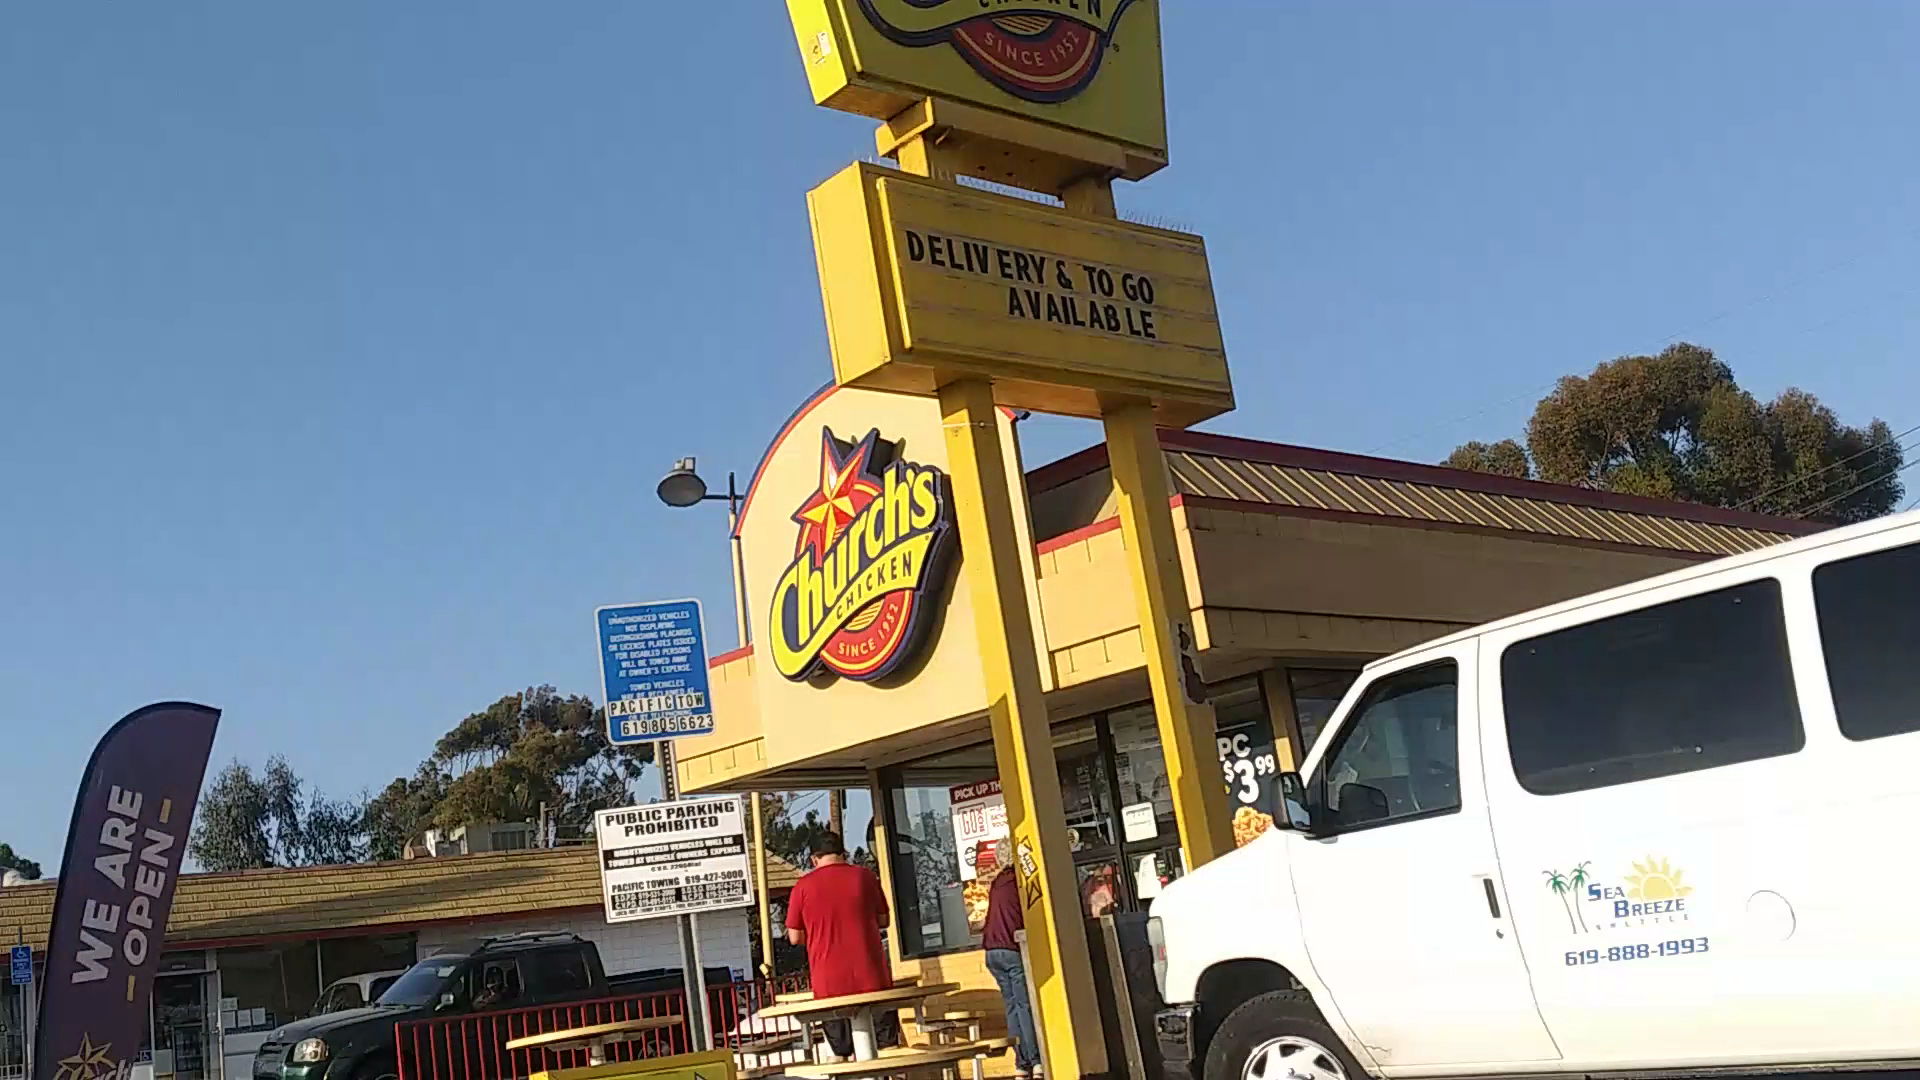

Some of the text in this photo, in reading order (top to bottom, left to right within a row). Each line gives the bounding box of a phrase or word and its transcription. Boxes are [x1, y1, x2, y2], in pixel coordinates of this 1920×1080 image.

[985, 31, 1079, 66] SINCE 1952
[906, 230, 1155, 304] DELIVERY & TO GO
[1008, 287, 1156, 339] AVAILABLE
[769, 463, 937, 676] Church's
[836, 550, 912, 622] CHICKEN
[838, 603, 899, 657] SINCE 1952
[610, 693, 704, 716] PACIFIC TOW
[1216, 733, 1252, 762] PC
[953, 785, 976, 801] PICK
[975, 782, 989, 796] UP
[605, 801, 735, 827] PUBLIC PARKING
[624, 816, 719, 838] PROHIBITED
[71, 784, 143, 985] WE ARE
[611, 869, 744, 893] PACIFIC TOWING 619-427-5000
[1587, 883, 1626, 902] SEA
[123, 828, 176, 967] OPEN
[1613, 898, 1686, 919] BREEZE
[1564, 936, 1710, 967] 619-888-1993
